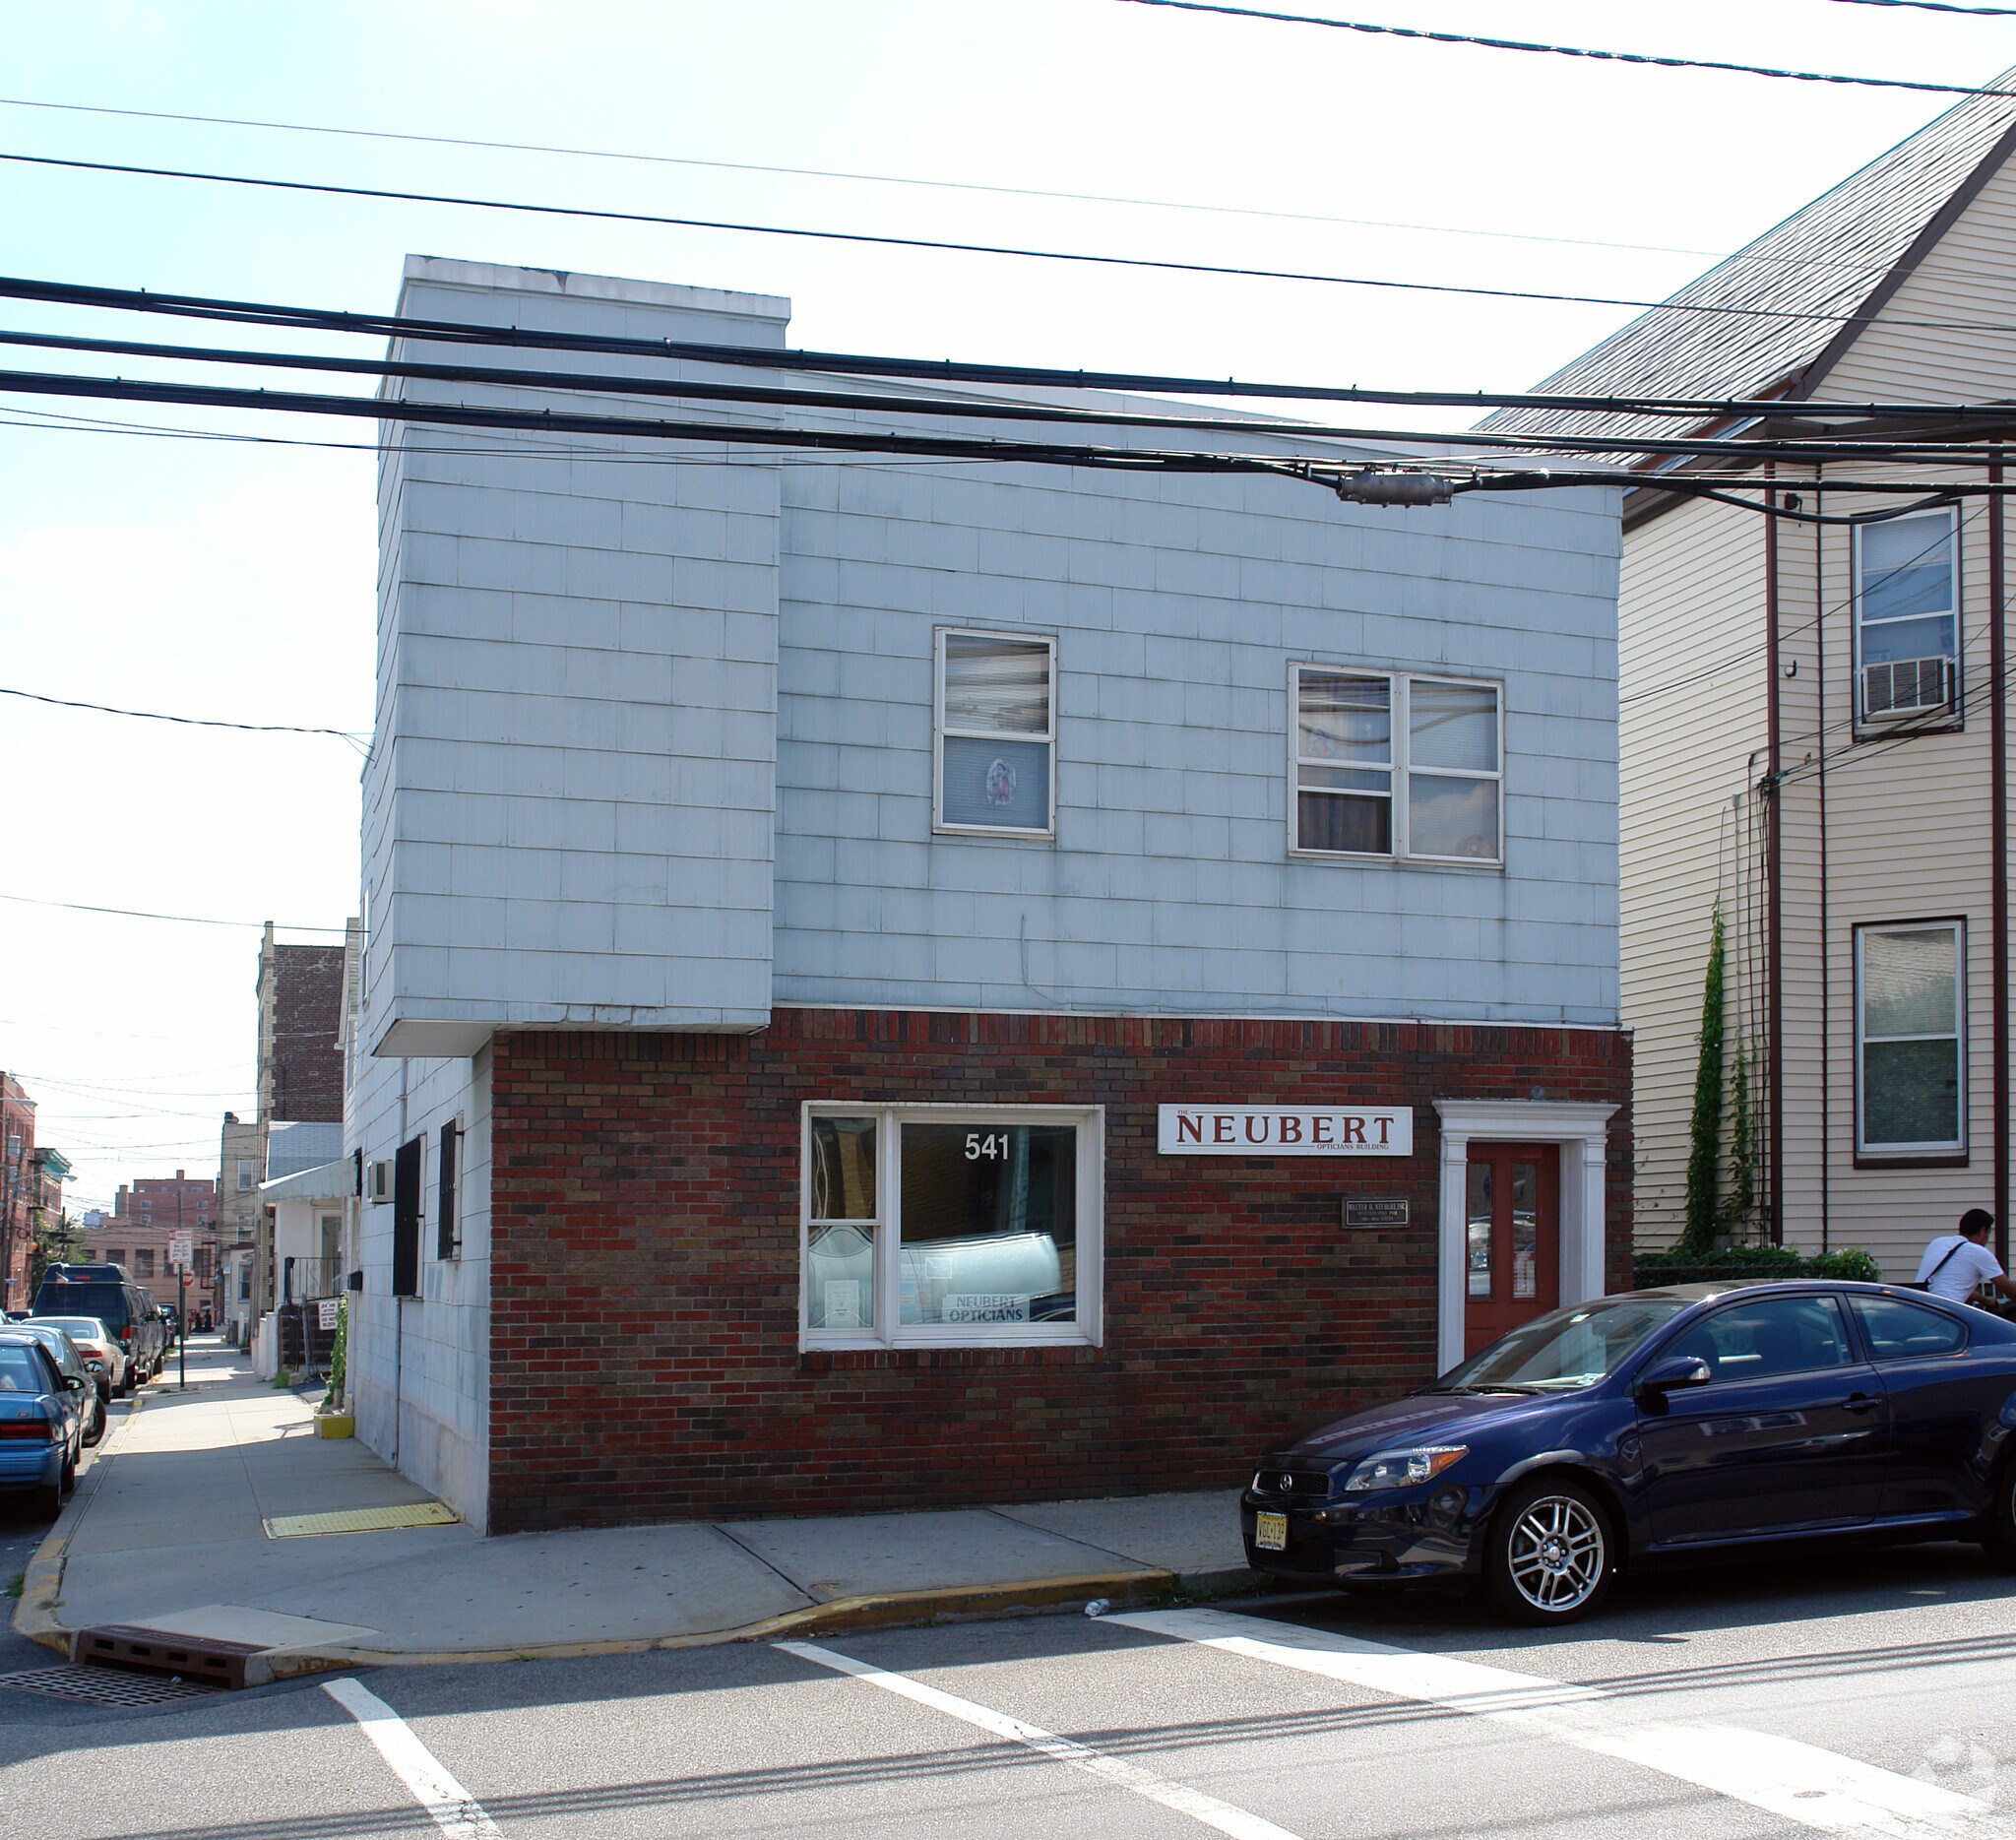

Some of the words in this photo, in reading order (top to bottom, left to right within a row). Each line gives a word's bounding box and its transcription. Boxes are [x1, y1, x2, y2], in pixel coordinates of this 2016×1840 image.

[1176, 1115, 1394, 1143] NEUBERT
[965, 1133, 1008, 1160] 541
[957, 1296, 1017, 1307] NEUBERT
[950, 1309, 1023, 1321] OPTICIANS
